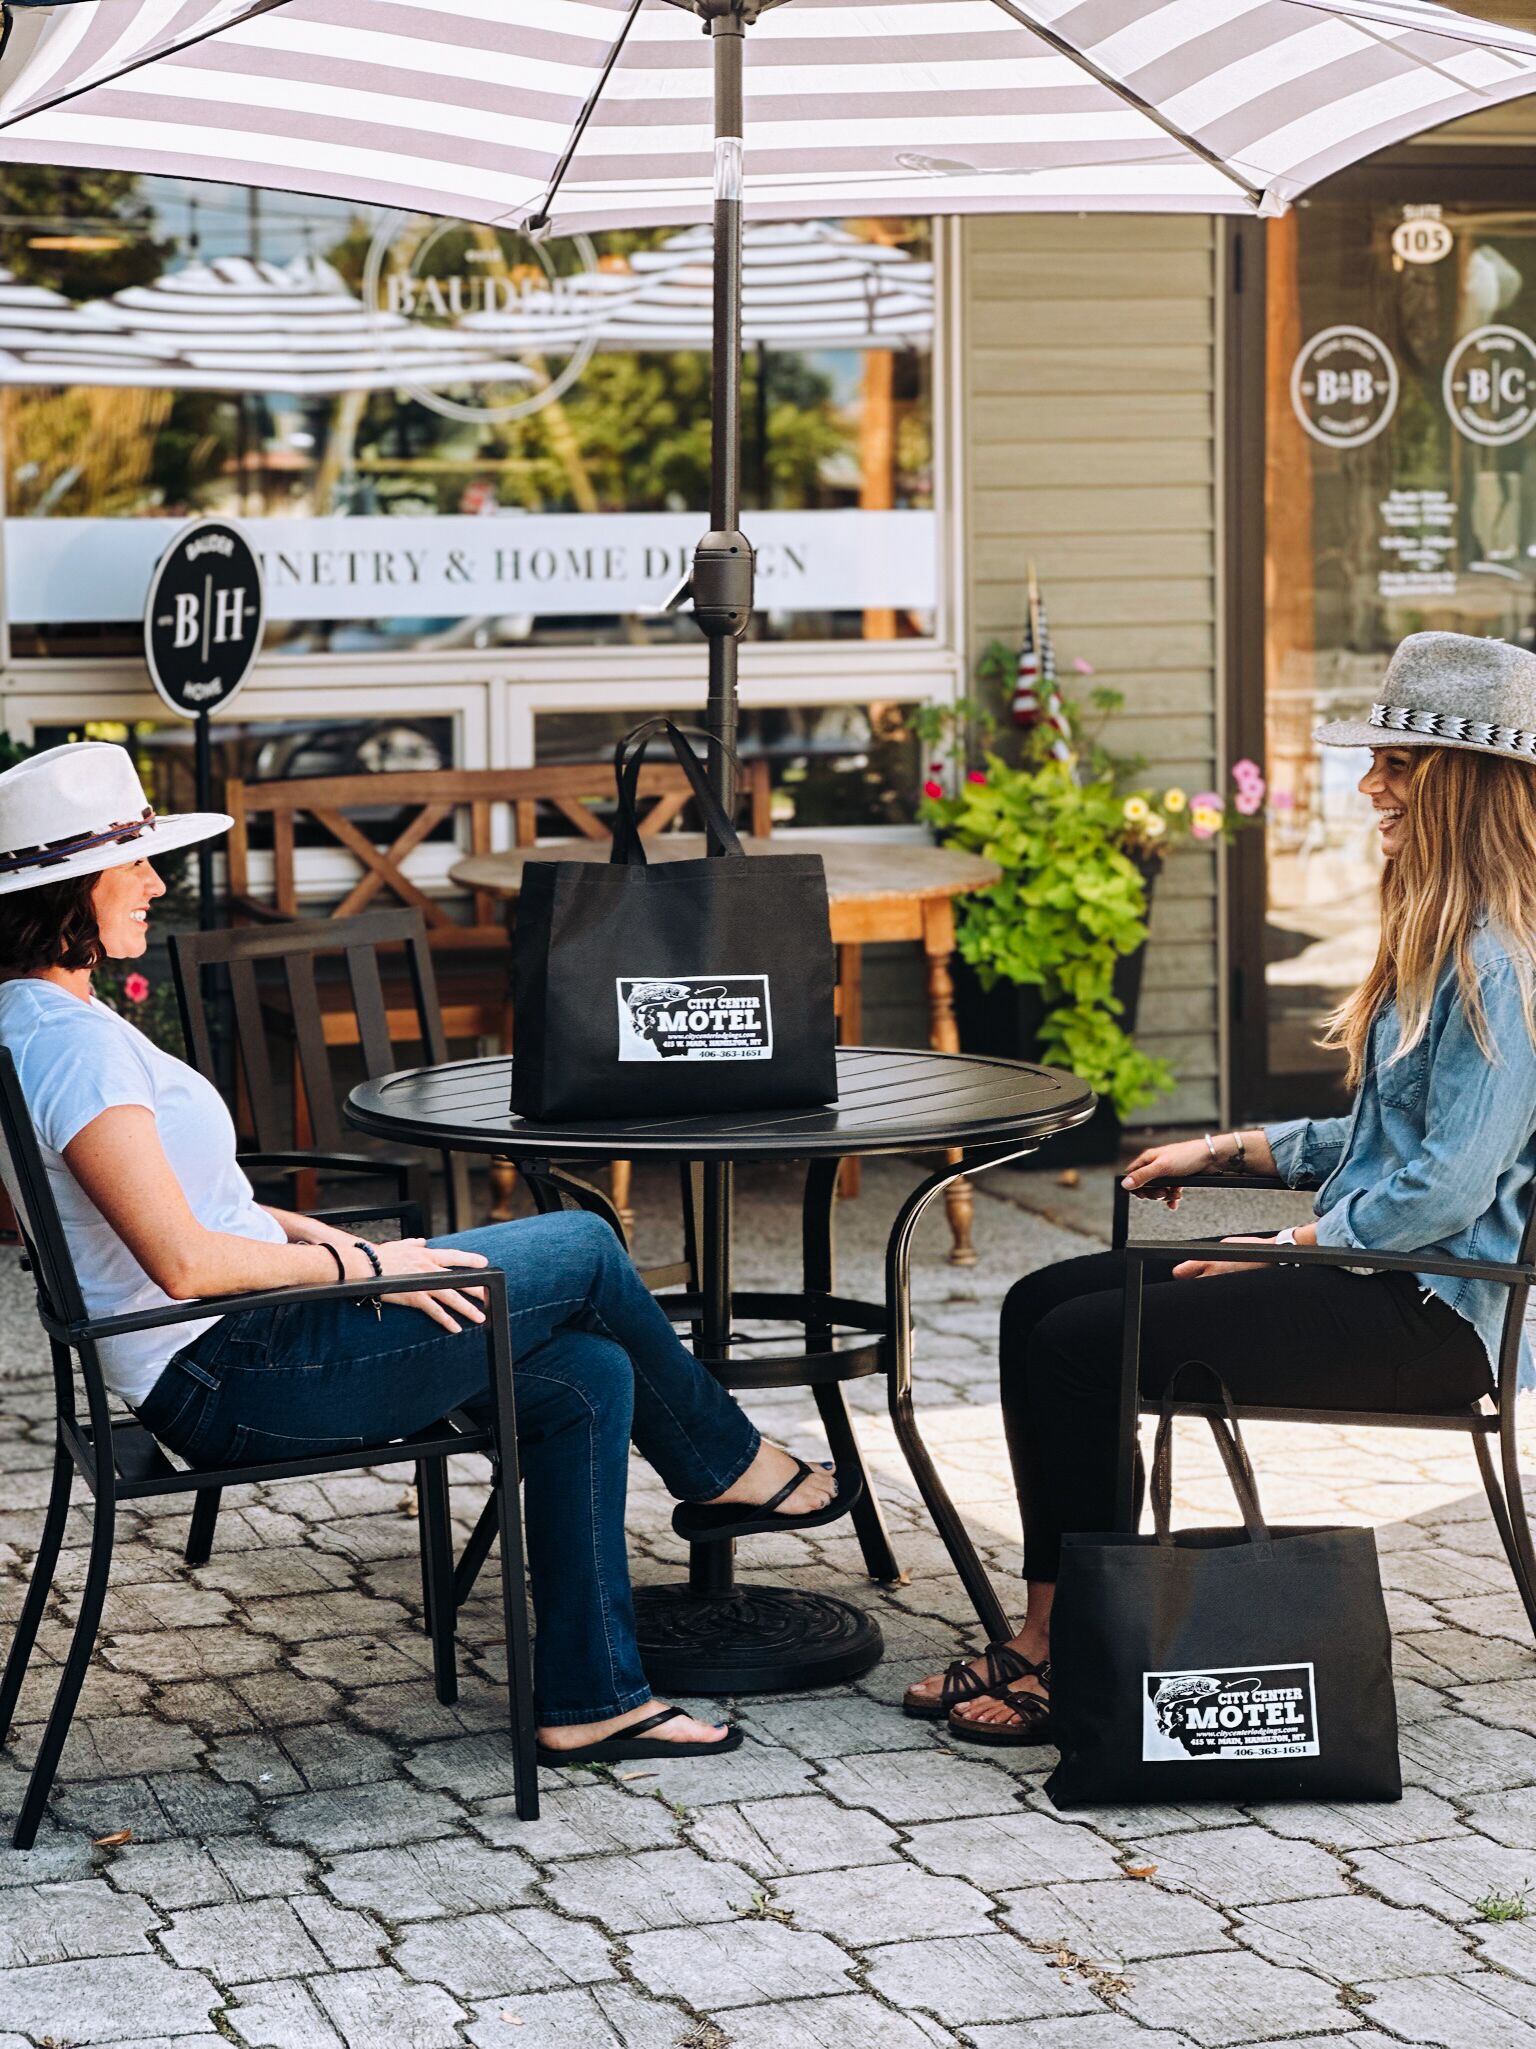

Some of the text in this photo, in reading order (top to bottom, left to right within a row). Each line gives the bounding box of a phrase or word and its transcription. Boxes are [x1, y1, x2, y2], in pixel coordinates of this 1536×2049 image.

[1403, 229, 1443, 252] 105
[445, 551, 475, 584] &
[494, 547, 627, 582] HOME
[644, 544, 810, 581] DEIGN
[687, 997, 761, 1010] CITY CENTER
[657, 1009, 762, 1032] MOTEL
[699, 1049, 762, 1058] 406-363-1651
[1217, 1687, 1304, 1706] CITY CENTER
[1185, 1701, 1305, 1730] MOTEL
[1190, 1738, 1204, 1746] 415
[1292, 1733, 1307, 1742] MT
[1195, 1726, 1299, 1738] www.citycenterlodgings.com
[1233, 1745, 1307, 1757] 406-363-1651
